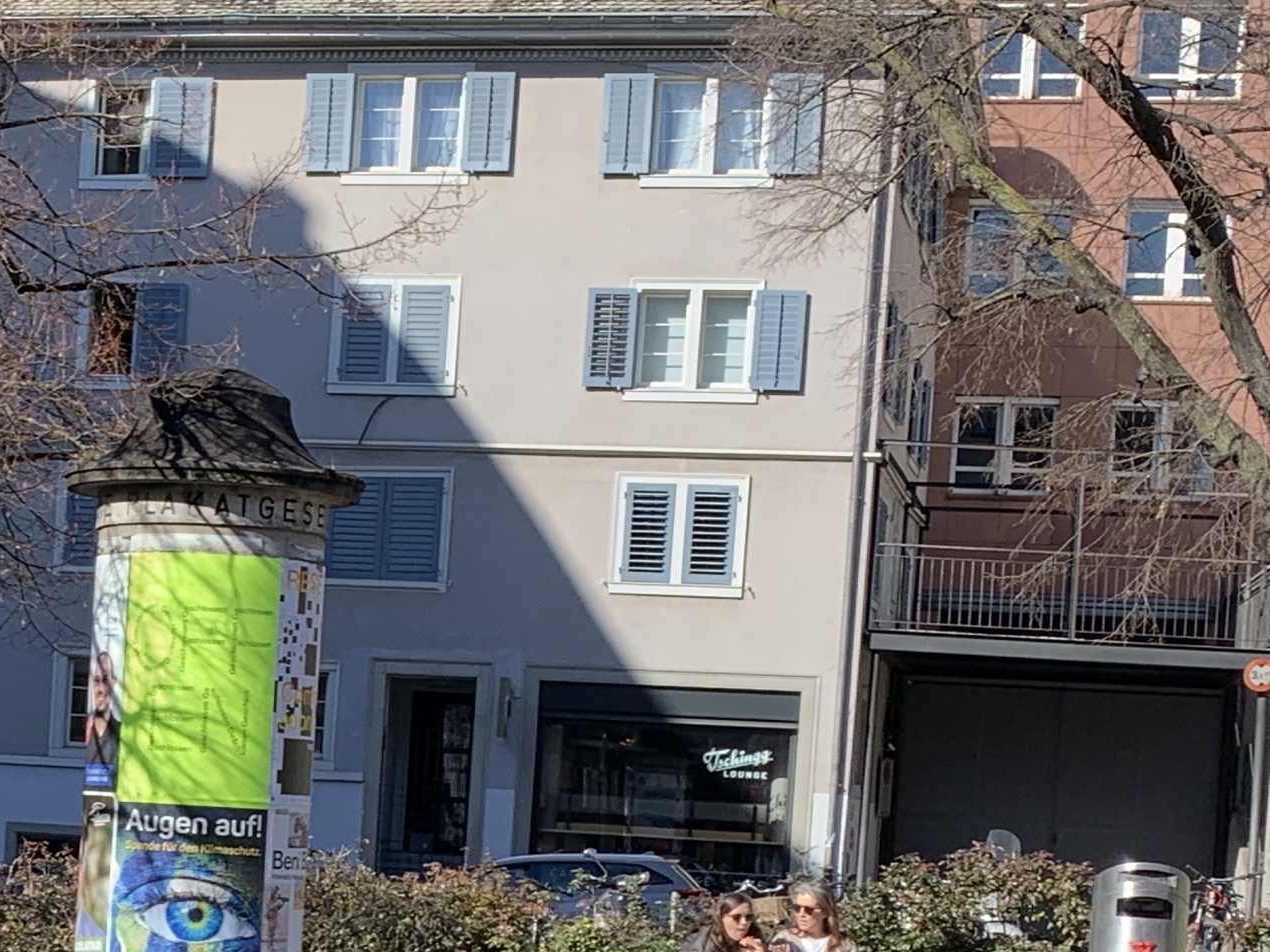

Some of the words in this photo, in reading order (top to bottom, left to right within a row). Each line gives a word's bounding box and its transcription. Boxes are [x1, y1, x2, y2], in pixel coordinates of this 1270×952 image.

[723, 770, 769, 780] LOUNGE
[125, 808, 208, 839] Augen
[214, 814, 263, 839] auf!
[125, 840, 161, 851] Spende
[161, 841, 177, 852] für
[179, 842, 199, 853] den
